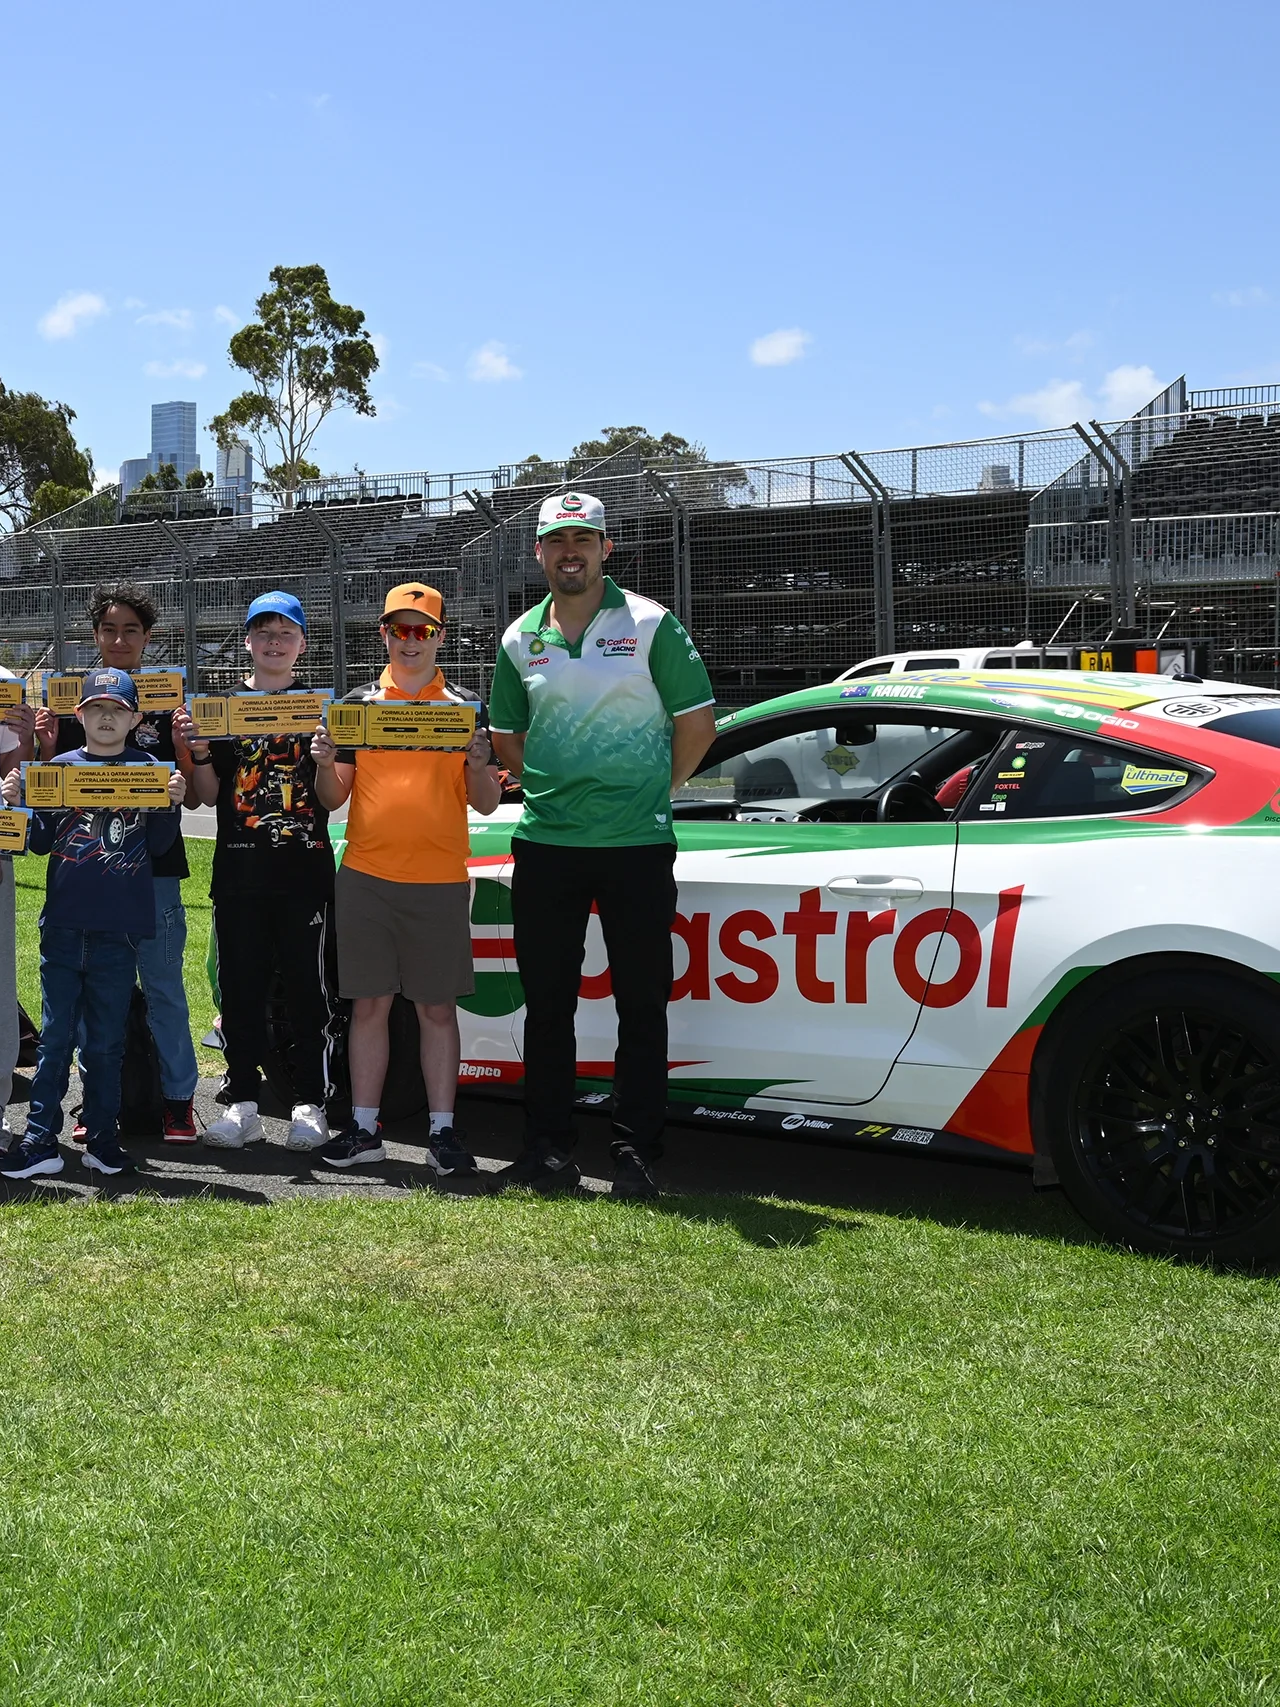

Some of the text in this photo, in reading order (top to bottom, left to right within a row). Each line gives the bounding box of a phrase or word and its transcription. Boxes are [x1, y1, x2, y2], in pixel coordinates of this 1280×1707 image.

[529, 657, 549, 667] RYCO
[872, 685, 930, 699] RANDLE
[1086, 713, 1139, 729] OGIO
[1127, 769, 1186, 783] ultimate
[458, 1062, 501, 1078] Repco
[693, 1106, 756, 1122] DesignEars
[803, 1119, 832, 1130] Miller
[894, 1134, 929, 1144] RACEGEAR
